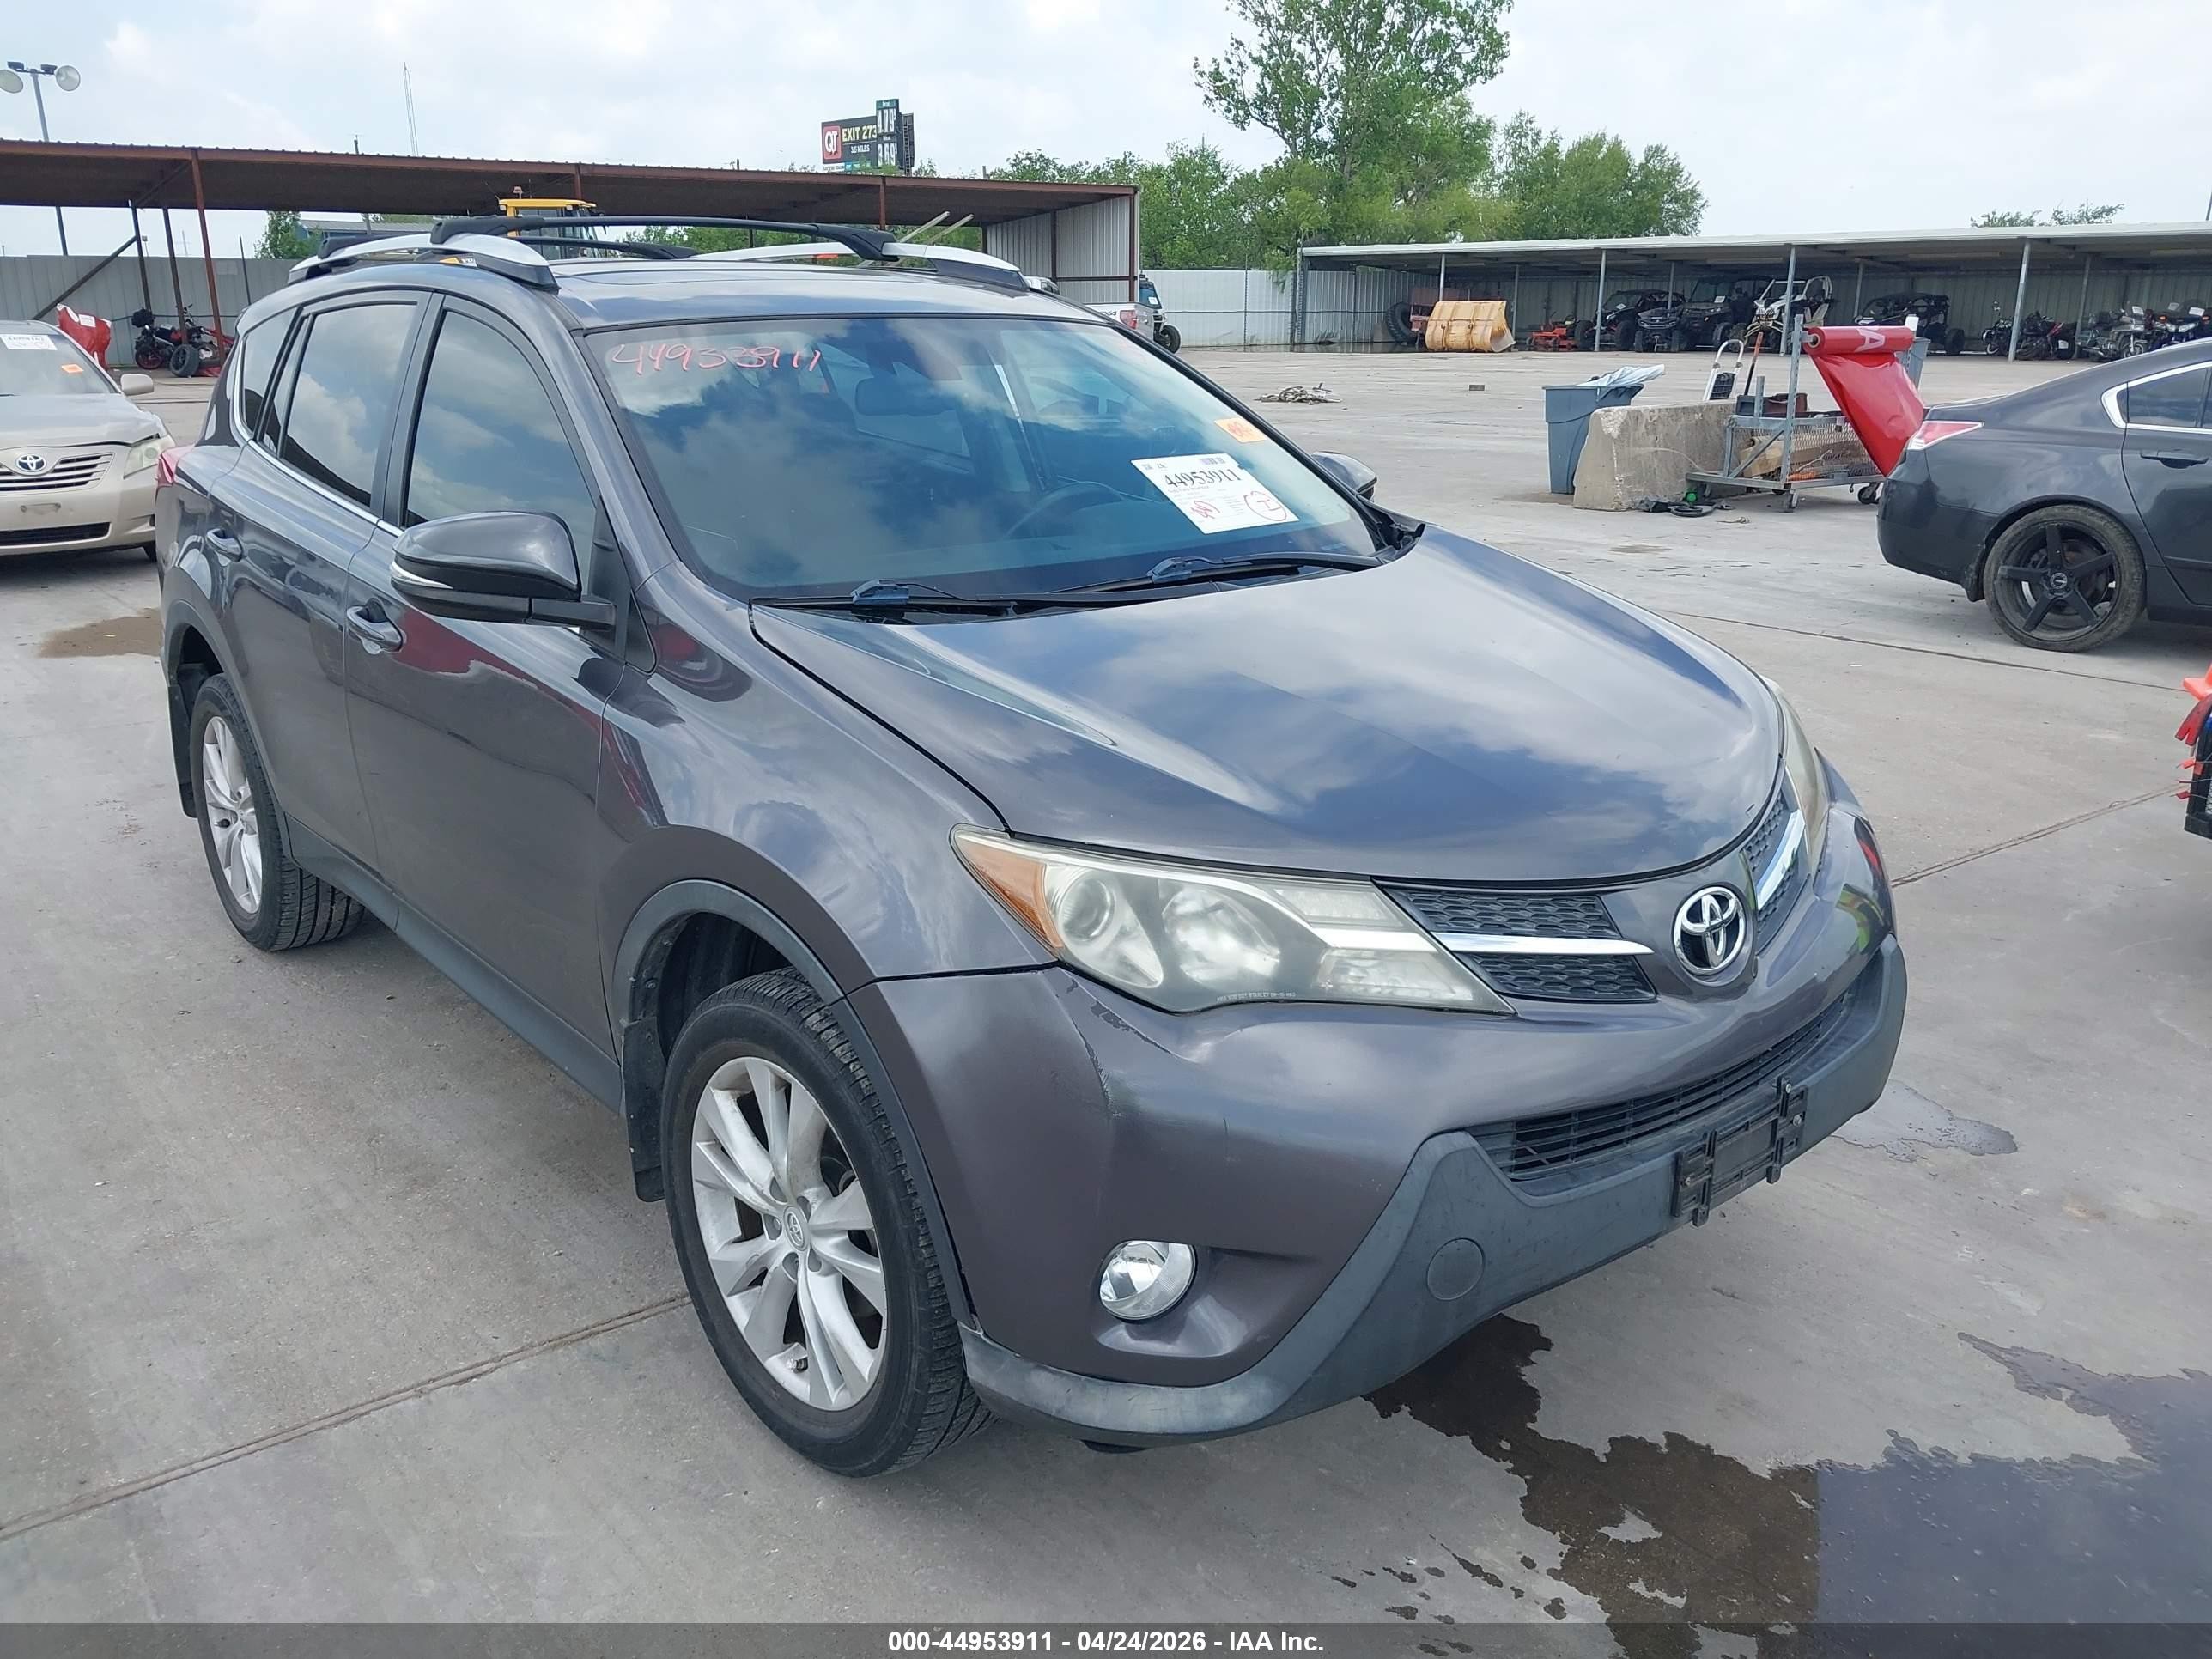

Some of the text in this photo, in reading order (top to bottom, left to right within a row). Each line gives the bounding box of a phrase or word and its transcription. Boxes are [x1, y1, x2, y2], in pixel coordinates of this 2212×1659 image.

[824, 130, 838, 154] QT
[842, 125, 877, 142] EXIT 273
[857, 144, 870, 153] MILES
[1164, 468, 1243, 487] 44953911
